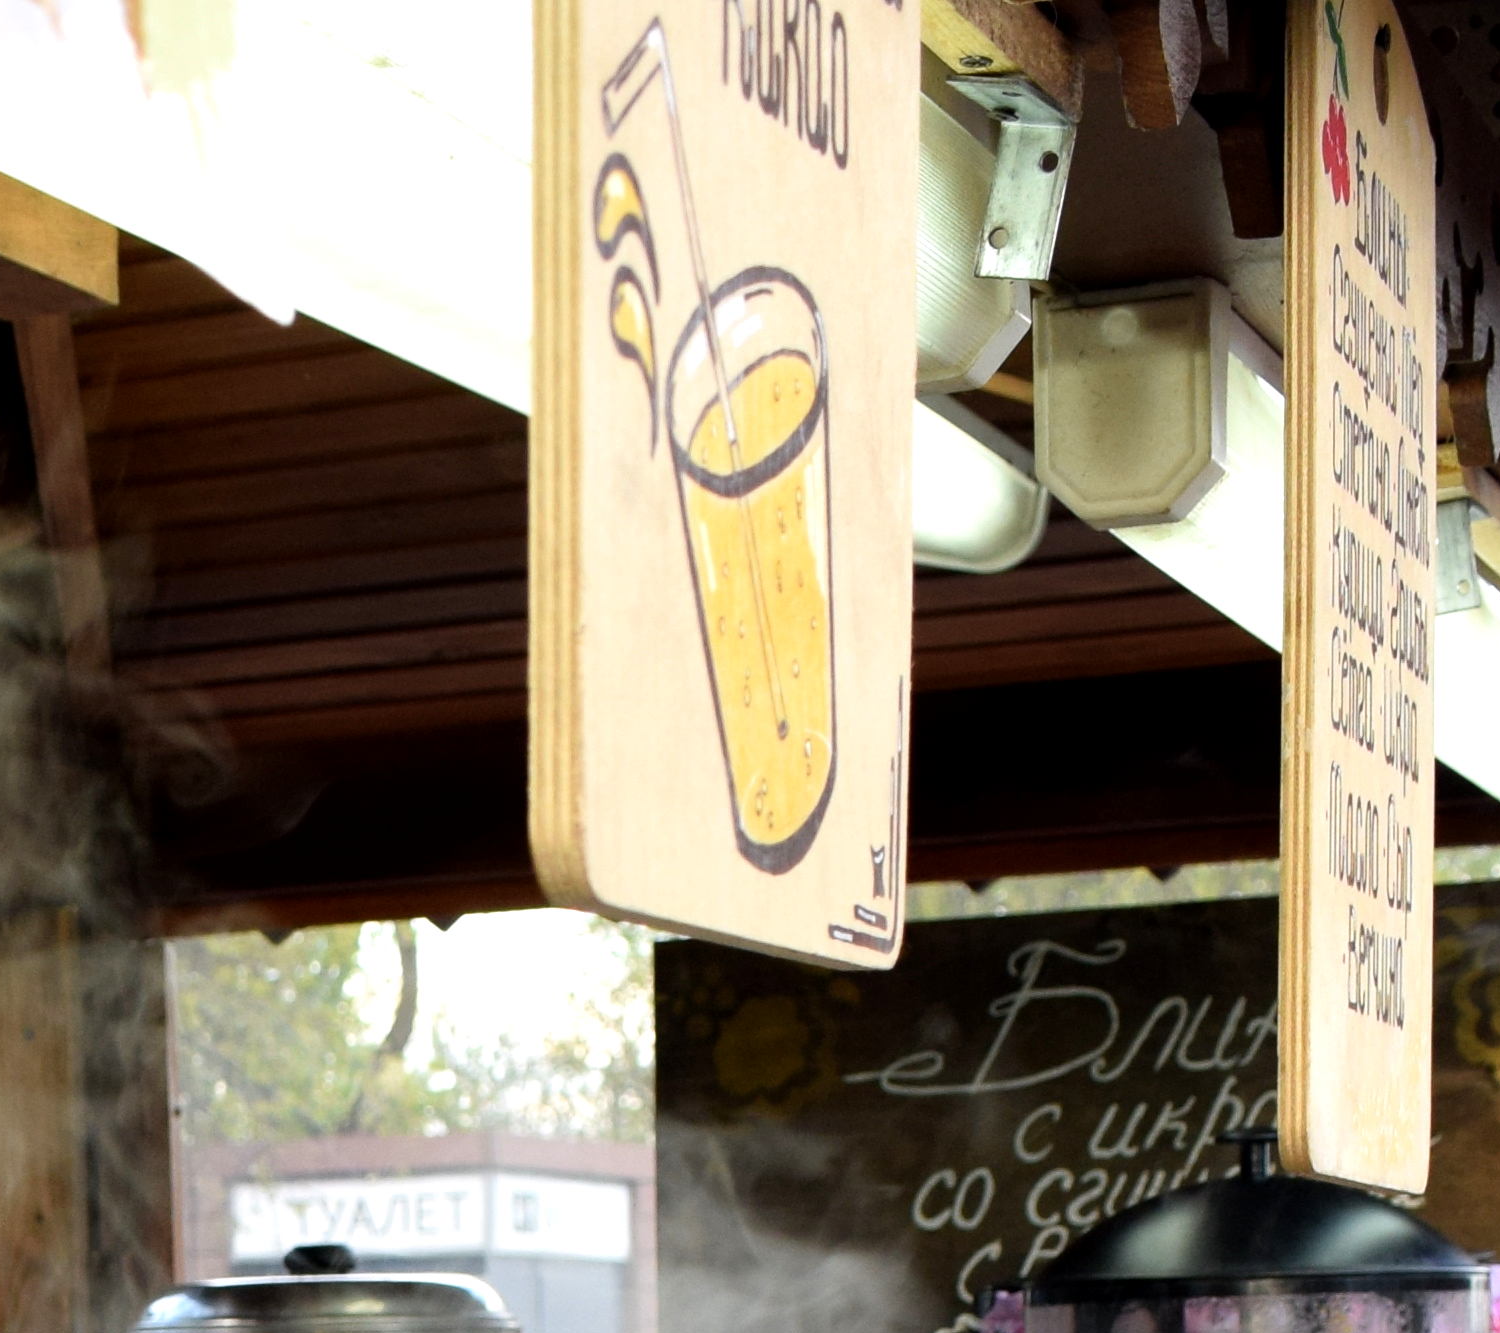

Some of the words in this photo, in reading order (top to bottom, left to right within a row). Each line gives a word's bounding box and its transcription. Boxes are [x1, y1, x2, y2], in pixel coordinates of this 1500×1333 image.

[1331, 503, 1385, 662] Курица
[1383, 663, 1420, 797] Икра
[1329, 760, 1380, 899] Масло
[1386, 793, 1413, 940] Сыр
[1347, 904, 1405, 1031] Ветчина
[1013, 1103, 1063, 1164] с
[284, 1190, 468, 1239] ТУАЛЕТ
[911, 1166, 996, 1231] со
